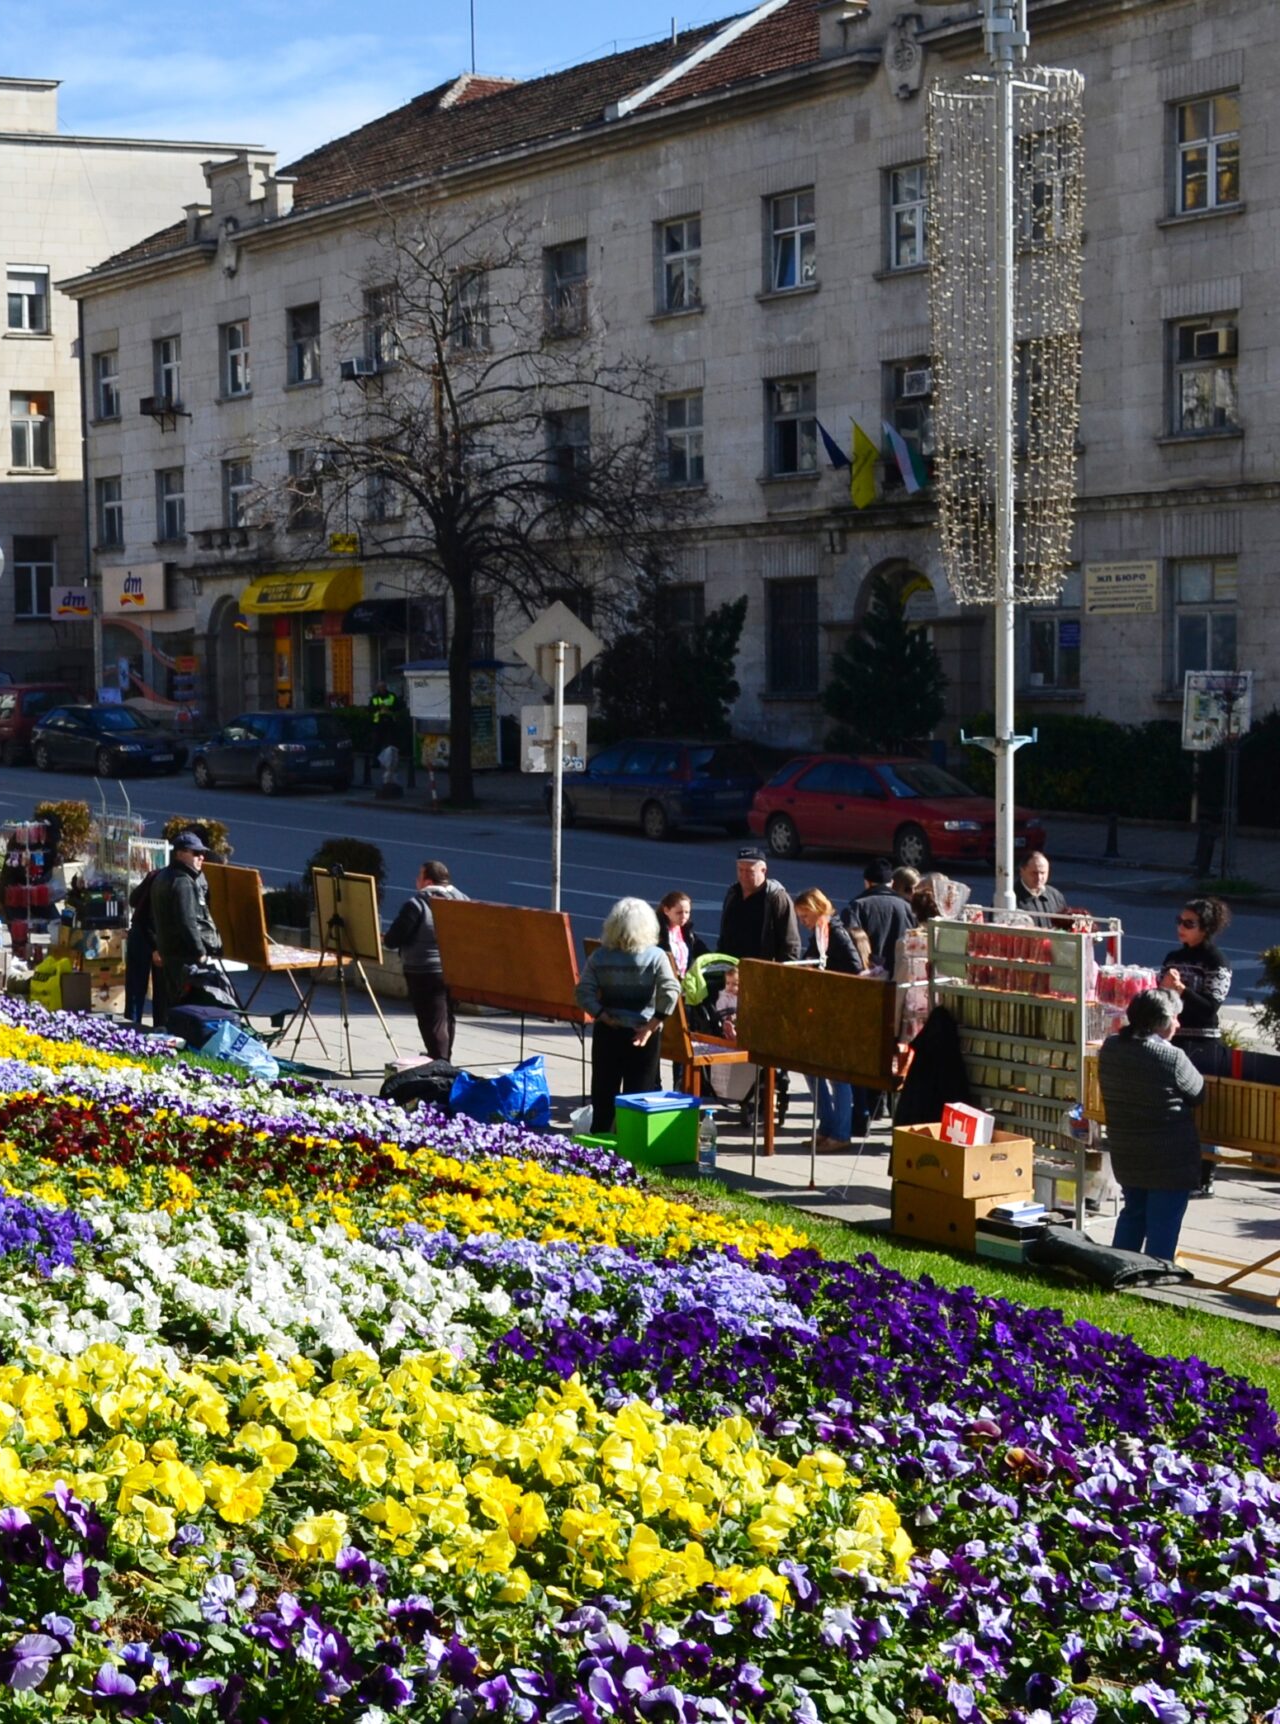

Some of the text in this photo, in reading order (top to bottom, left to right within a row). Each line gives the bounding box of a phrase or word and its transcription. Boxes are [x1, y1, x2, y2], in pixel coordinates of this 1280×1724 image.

[124, 571, 142, 593] dm
[1096, 573, 1146, 583] ЖП БЮРО
[62, 591, 86, 606] dm
